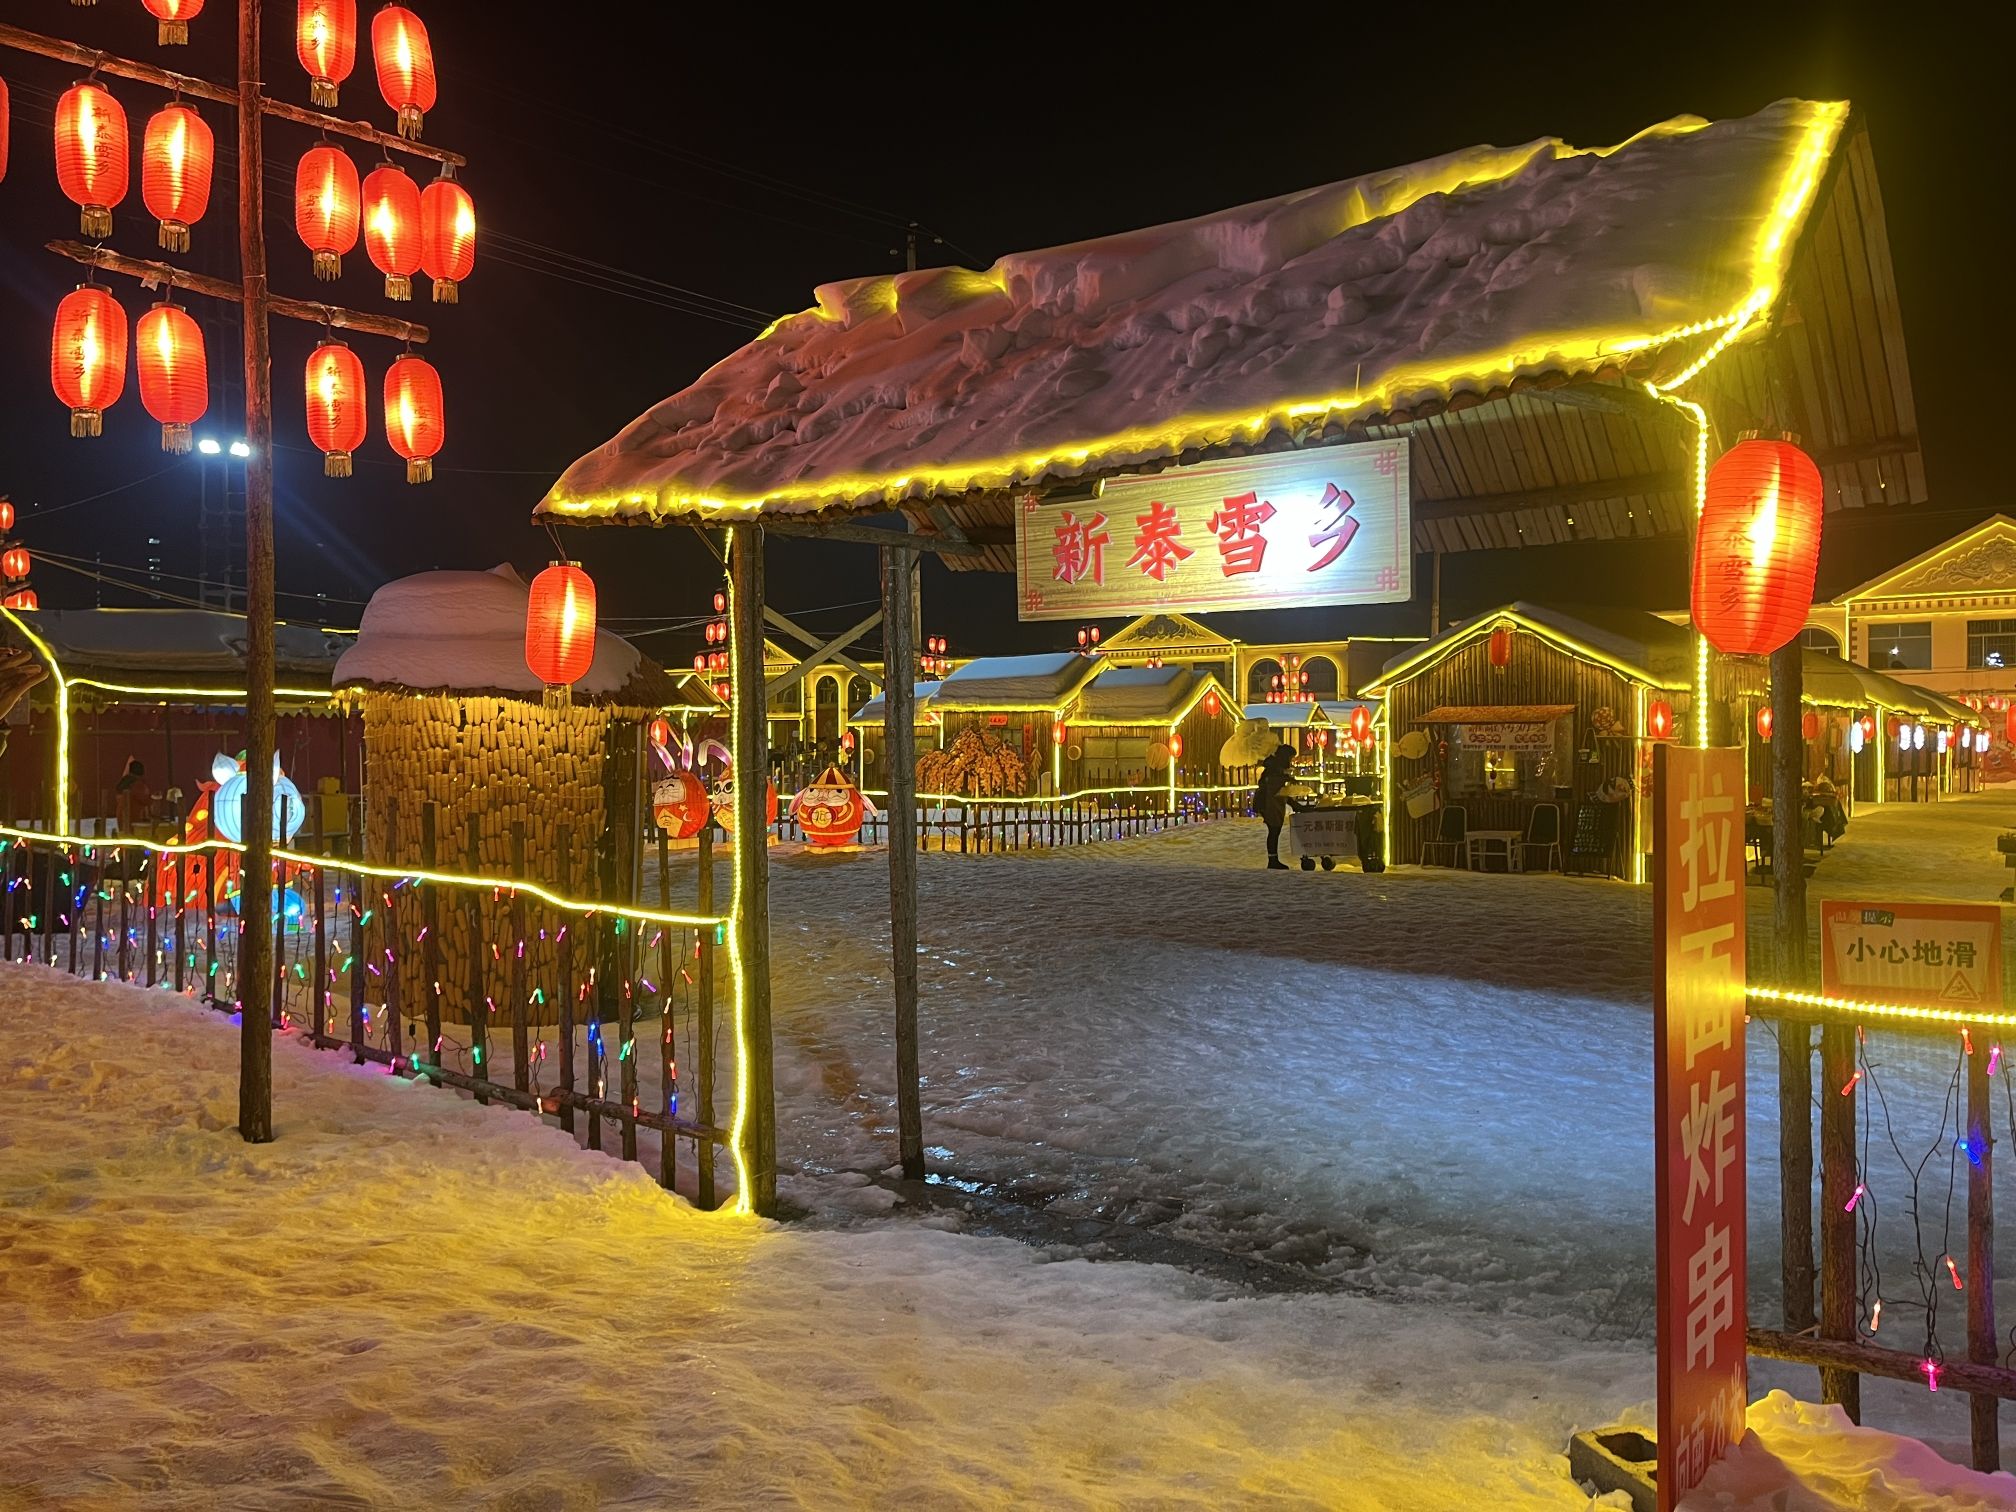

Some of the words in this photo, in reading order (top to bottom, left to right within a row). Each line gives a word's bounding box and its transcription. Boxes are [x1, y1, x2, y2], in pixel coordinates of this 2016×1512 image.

[92, 106, 113, 177] 新泰雪乡
[70, 308, 91, 380] 新泰雪乡
[1051, 481, 1361, 586] 新泰雪乡
[1846, 936, 1978, 969] 小心地滑
[1679, 772, 1737, 1373] 拉面炸串
